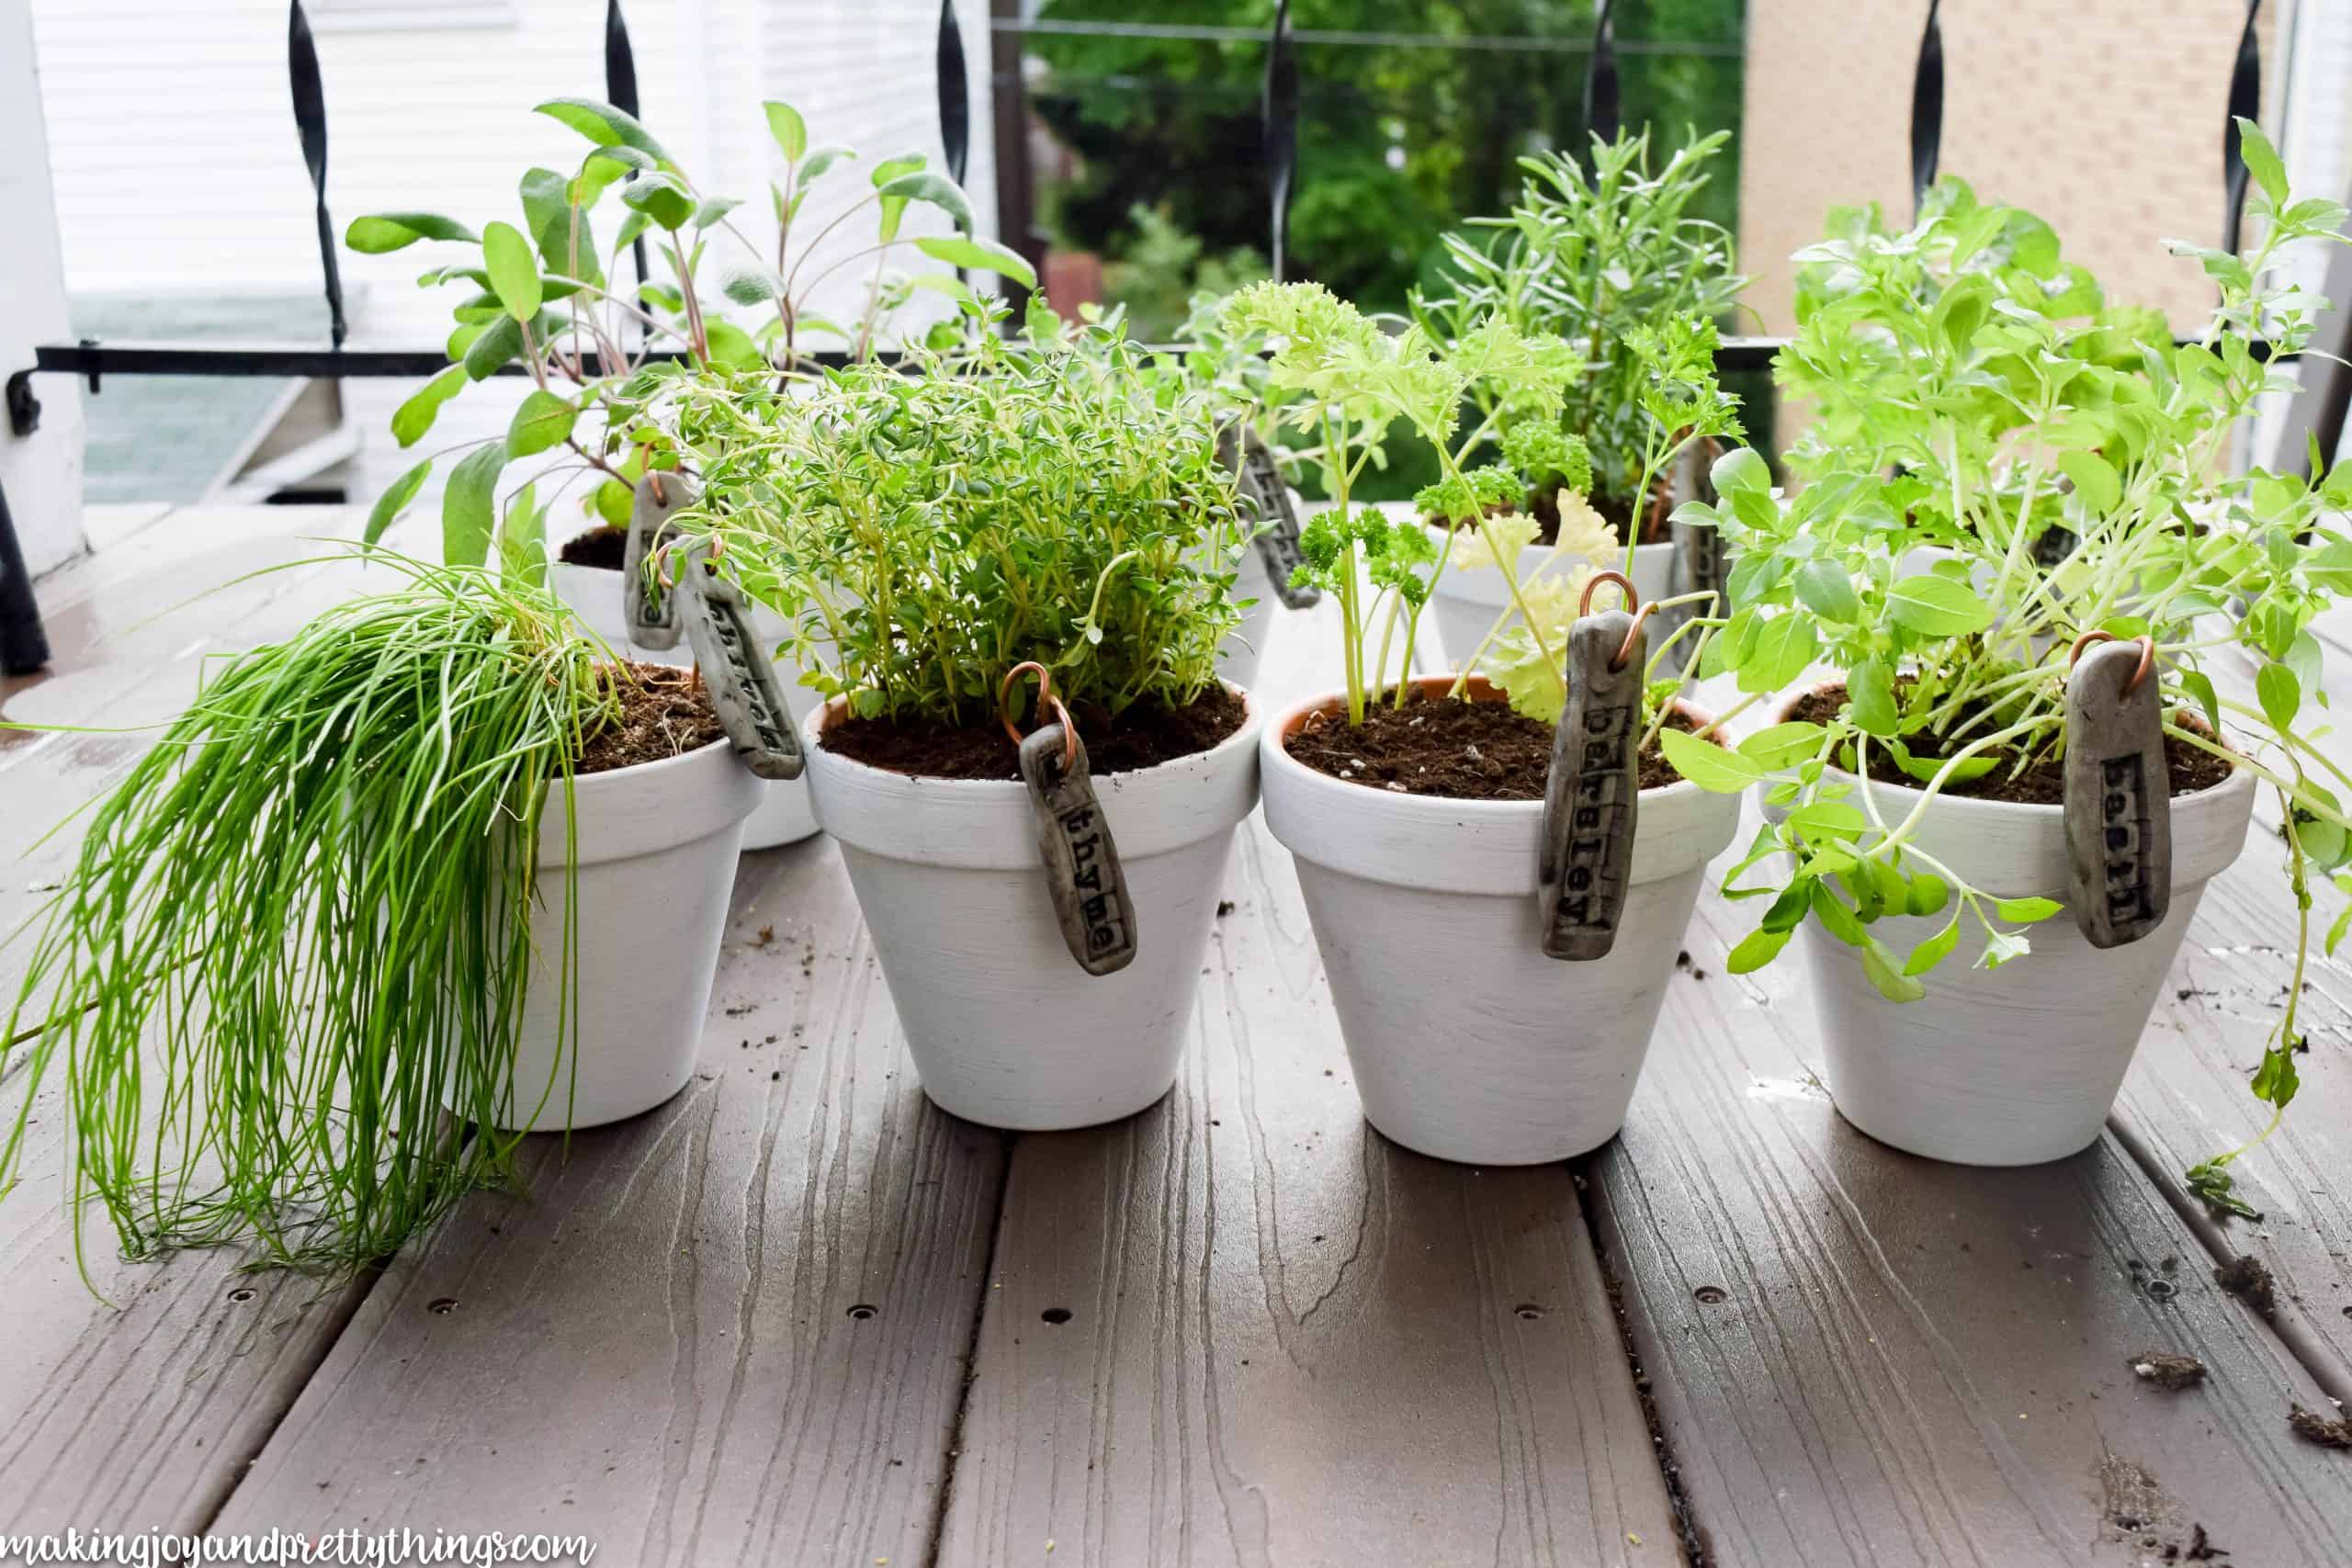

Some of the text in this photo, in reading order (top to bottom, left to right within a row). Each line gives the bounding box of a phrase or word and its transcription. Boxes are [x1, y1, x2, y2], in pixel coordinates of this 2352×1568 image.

[1063, 808, 1115, 952] thyme
[1557, 710, 1612, 926] parsley
[2102, 759, 2138, 923] basil
